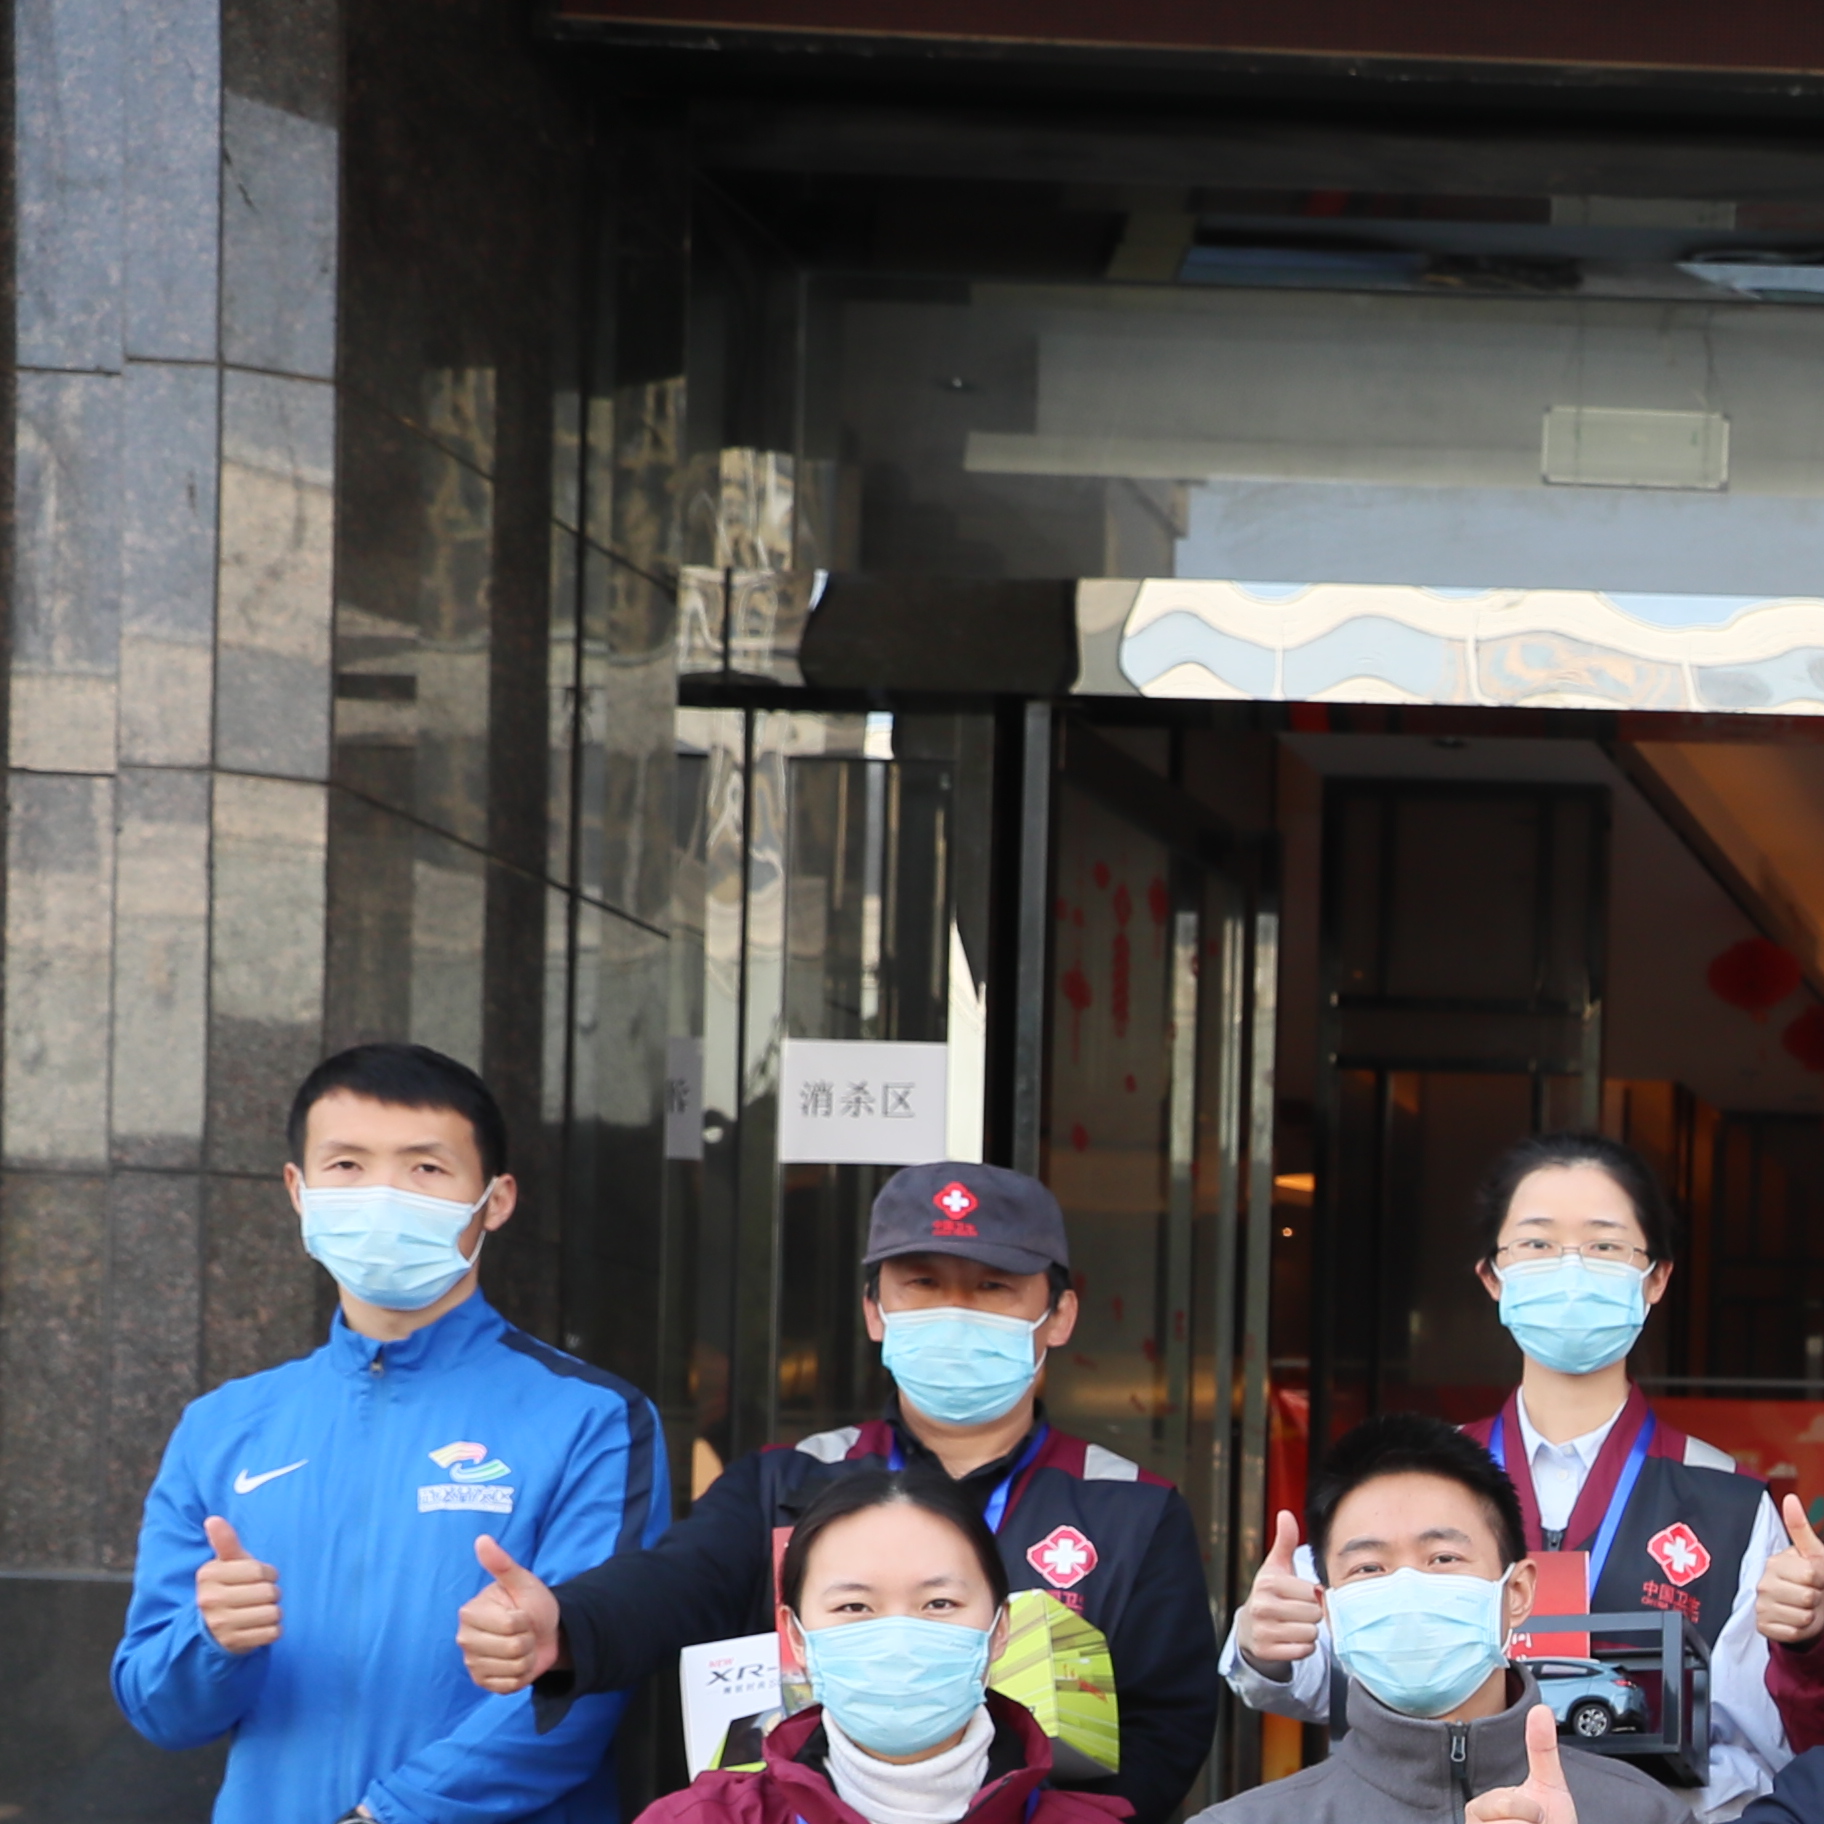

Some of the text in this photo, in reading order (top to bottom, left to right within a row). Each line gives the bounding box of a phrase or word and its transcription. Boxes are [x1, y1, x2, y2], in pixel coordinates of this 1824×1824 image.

[801, 1082, 916, 1118] 消杀区
[1643, 1579, 1701, 1611] 中国卫生
[706, 1663, 779, 1686] XR-
